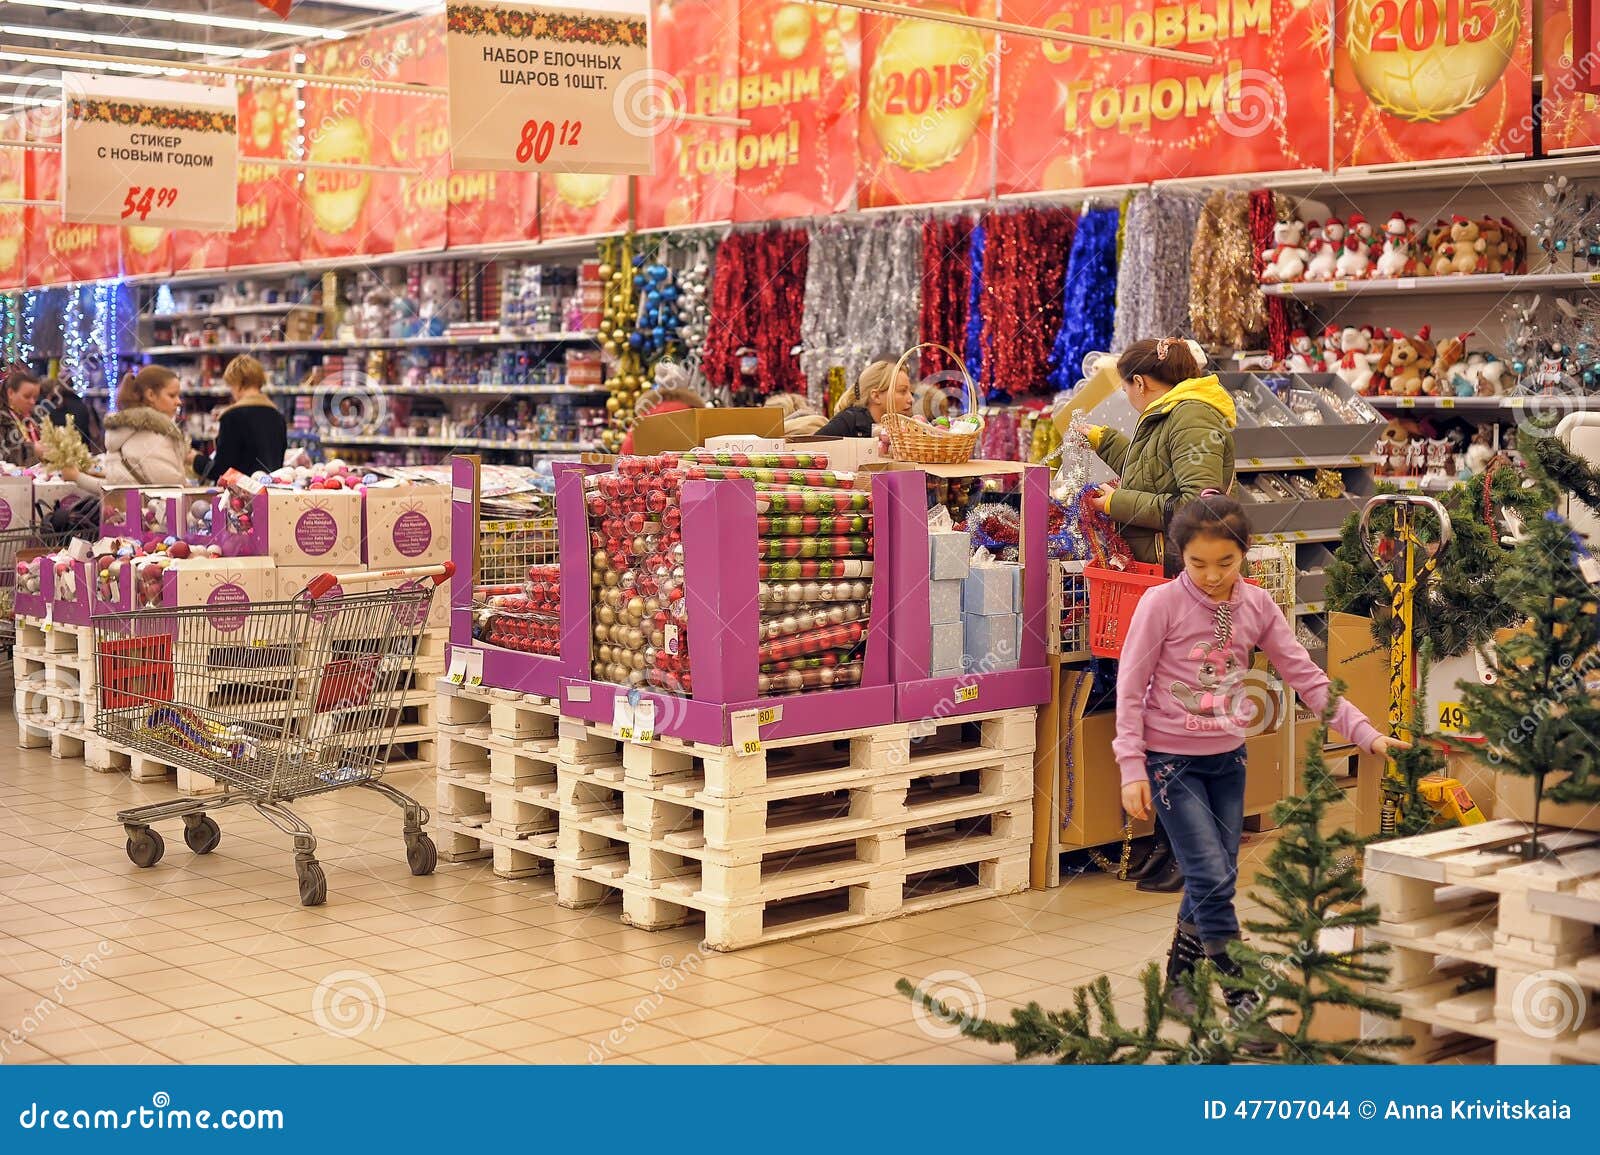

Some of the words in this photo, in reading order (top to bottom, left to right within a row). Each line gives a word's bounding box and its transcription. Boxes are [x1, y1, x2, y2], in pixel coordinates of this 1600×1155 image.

[1370, 0, 1497, 51] 2015
[483, 46, 539, 65] НАБОР
[544, 51, 622, 71] ЕЛОЧНЫХ
[500, 69, 559, 87] ШАРОВ
[564, 74, 607, 90] 10ШТ.
[695, 66, 821, 114] Новым
[884, 64, 974, 115] 2015
[1065, 58, 1243, 135] Годом!
[97, 146, 107, 158] С
[110, 148, 163, 163] НОВЫМ
[167, 152, 213, 167] ГОДОМ
[130, 133, 182, 148] СТИКЕР
[679, 120, 799, 178] Годом!
